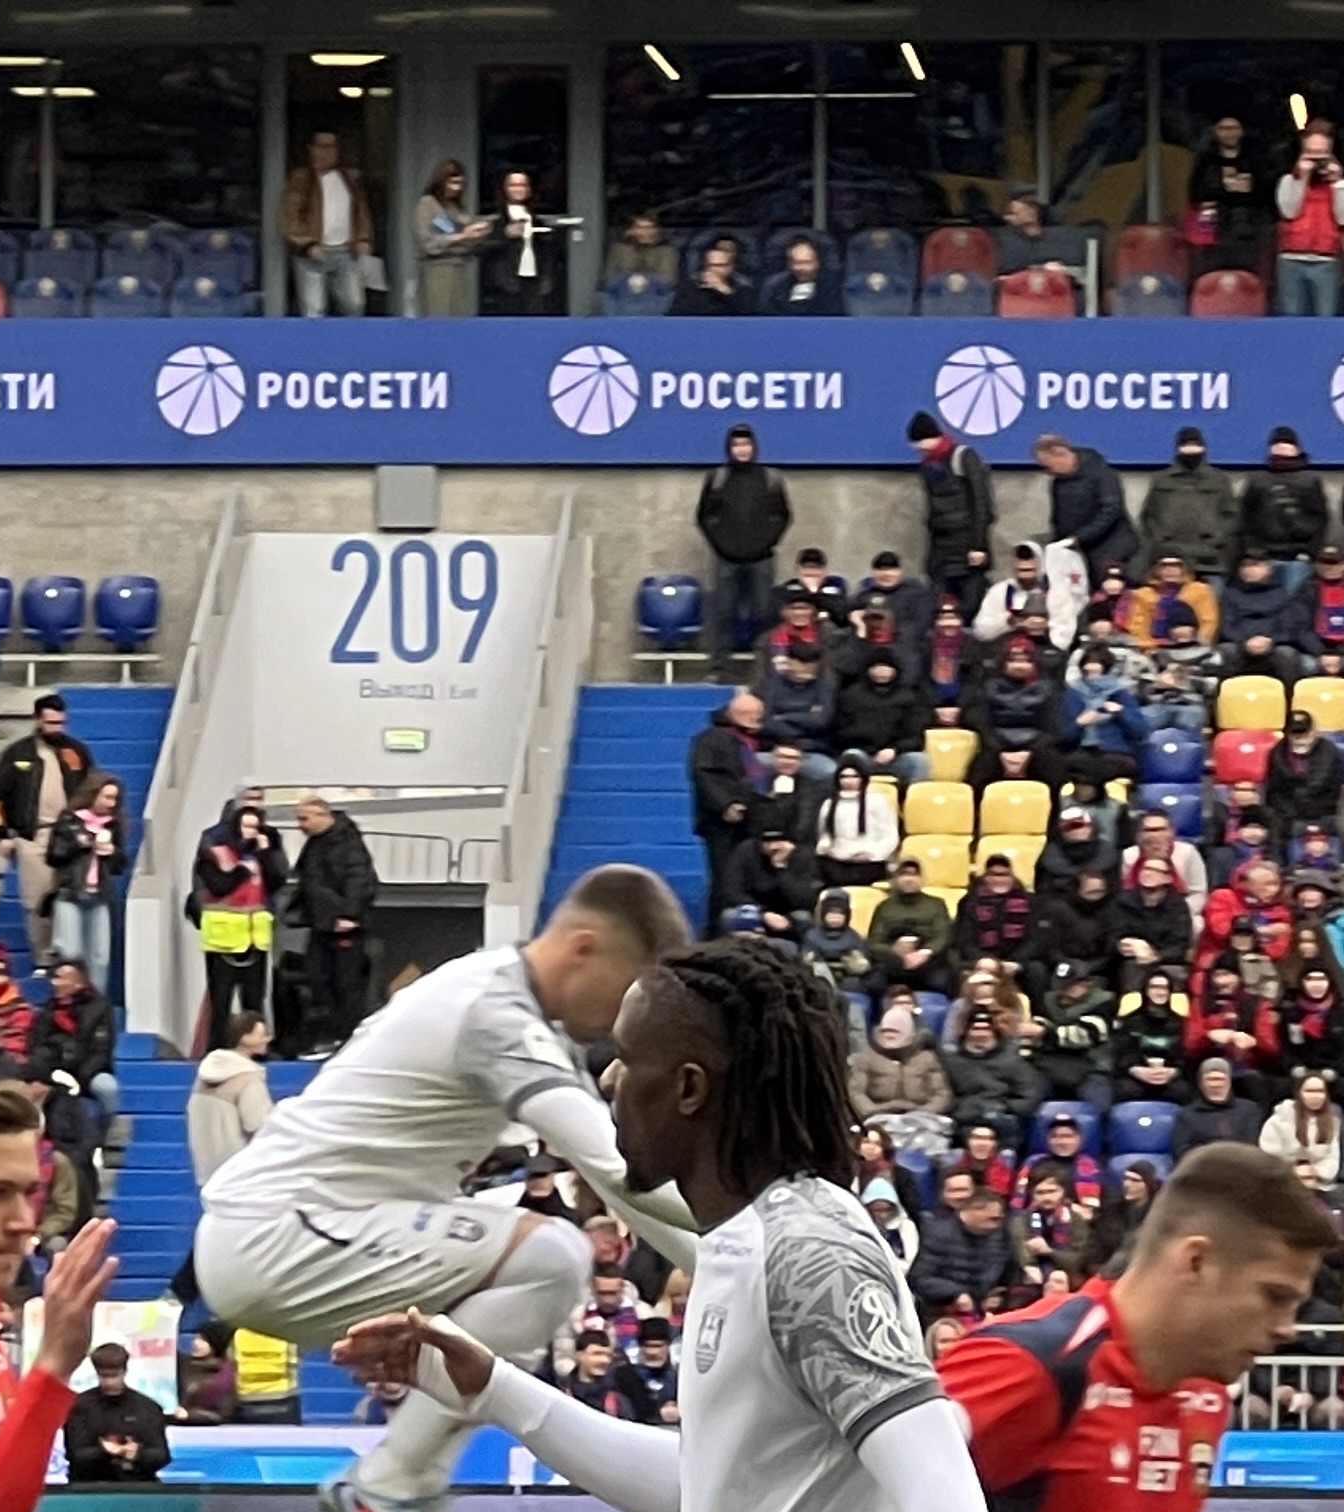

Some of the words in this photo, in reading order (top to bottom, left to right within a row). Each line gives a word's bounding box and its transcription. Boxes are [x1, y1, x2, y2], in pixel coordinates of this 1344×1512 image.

[257, 371, 448, 409] РОССЕТИ
[651, 371, 842, 409] РОССЕТИ
[1038, 372, 1229, 410] РОССЕТИ
[330, 539, 499, 664] 209
